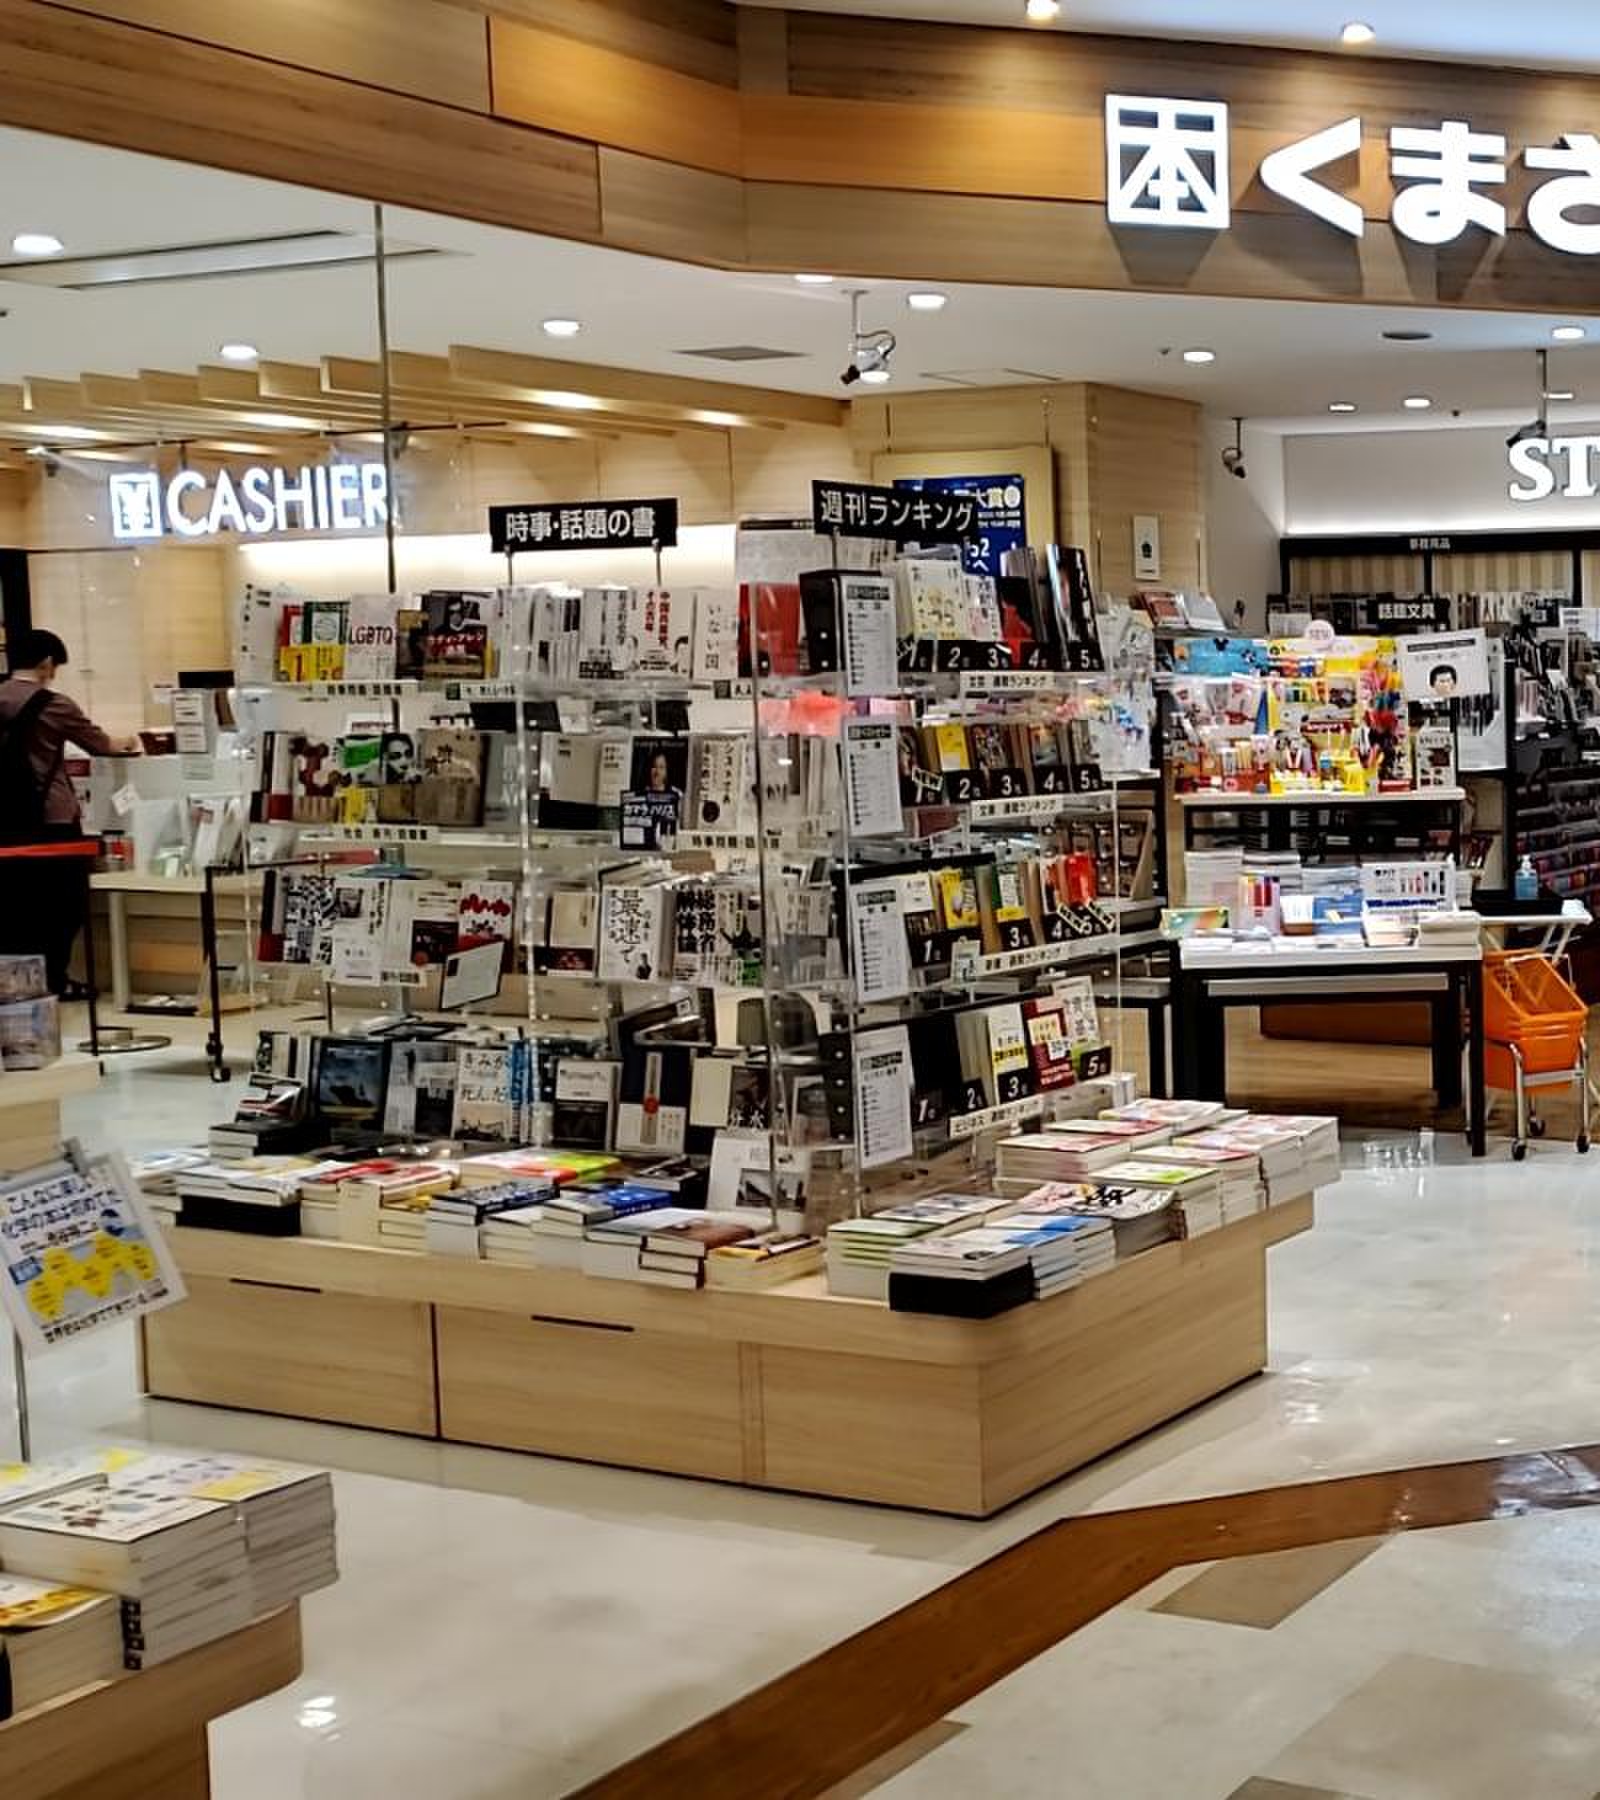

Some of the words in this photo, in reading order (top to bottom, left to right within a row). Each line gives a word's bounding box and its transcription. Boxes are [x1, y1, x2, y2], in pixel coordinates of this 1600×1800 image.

[167, 463, 390, 537] CASHIER
[819, 488, 975, 532] 週刊ランキング
[505, 505, 656, 540] 時事・話題の書
